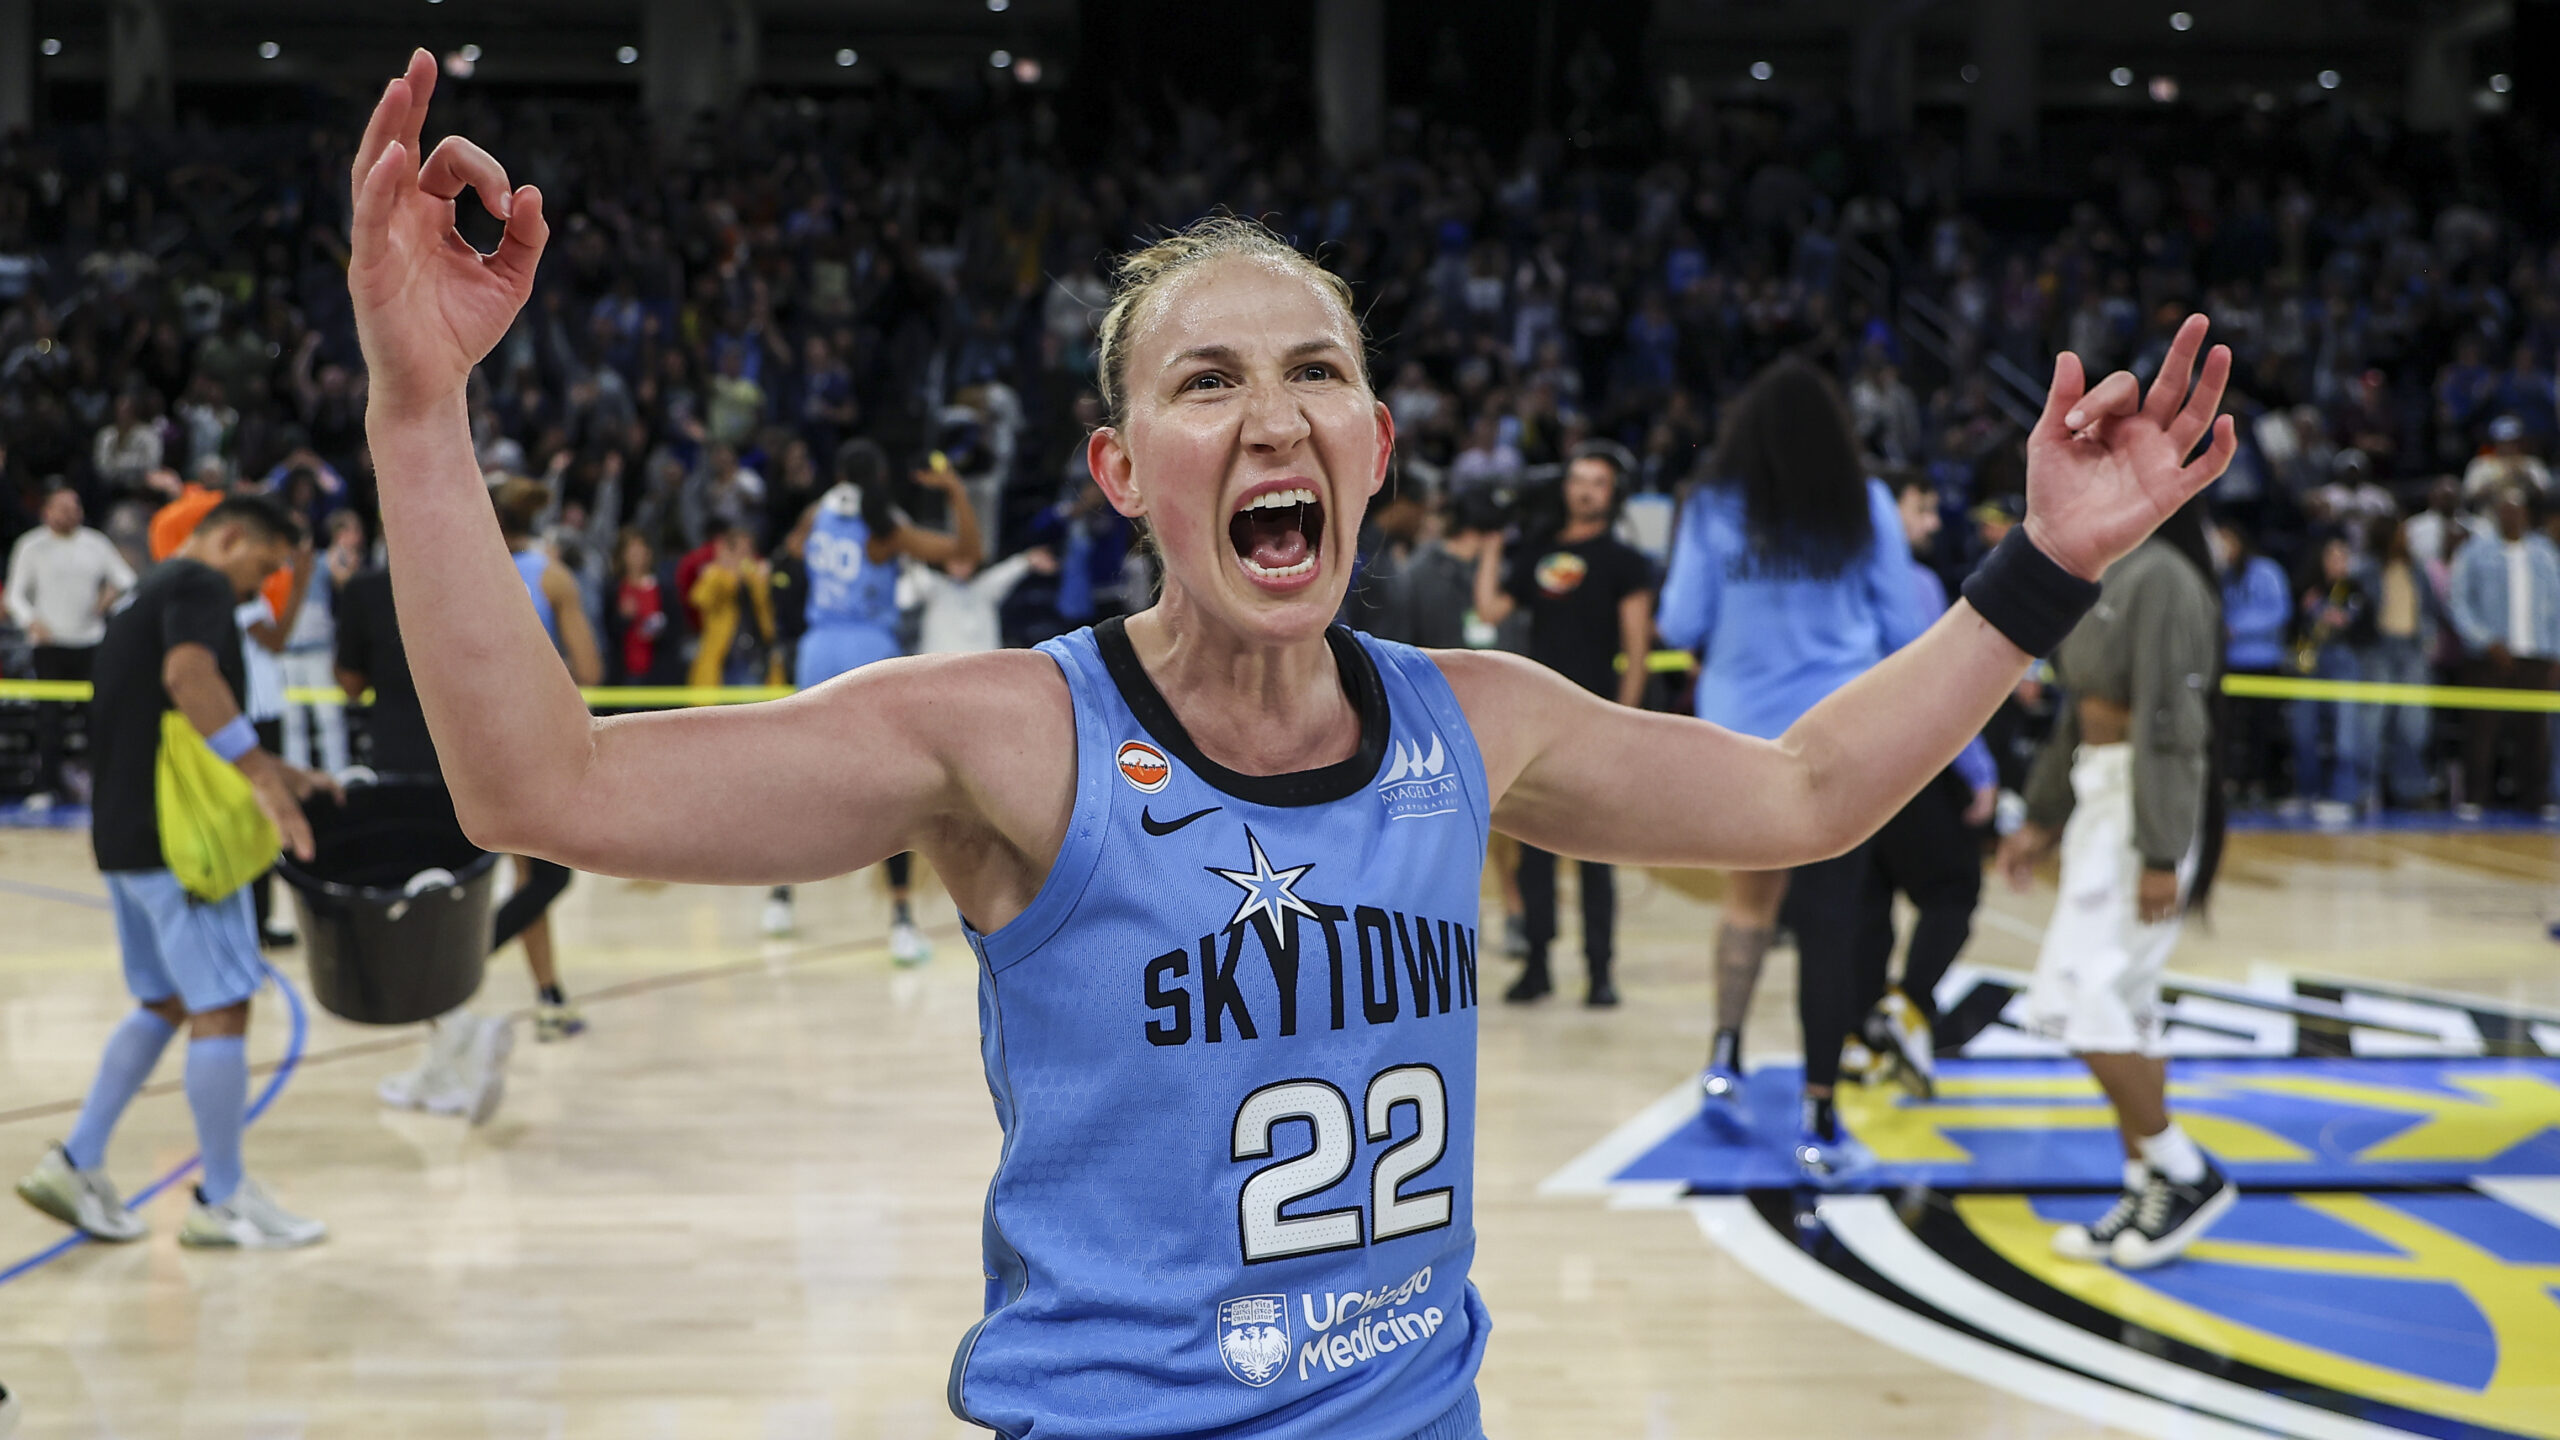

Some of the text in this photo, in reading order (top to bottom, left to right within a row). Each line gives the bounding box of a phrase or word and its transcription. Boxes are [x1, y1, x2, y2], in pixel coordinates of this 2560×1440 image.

[1381, 780, 1458, 805] MAGELLAN
[1144, 900, 1478, 1047] SKYTOWN
[1231, 1062, 1454, 1266] 22
[1299, 1306, 1443, 1381] Medicine
